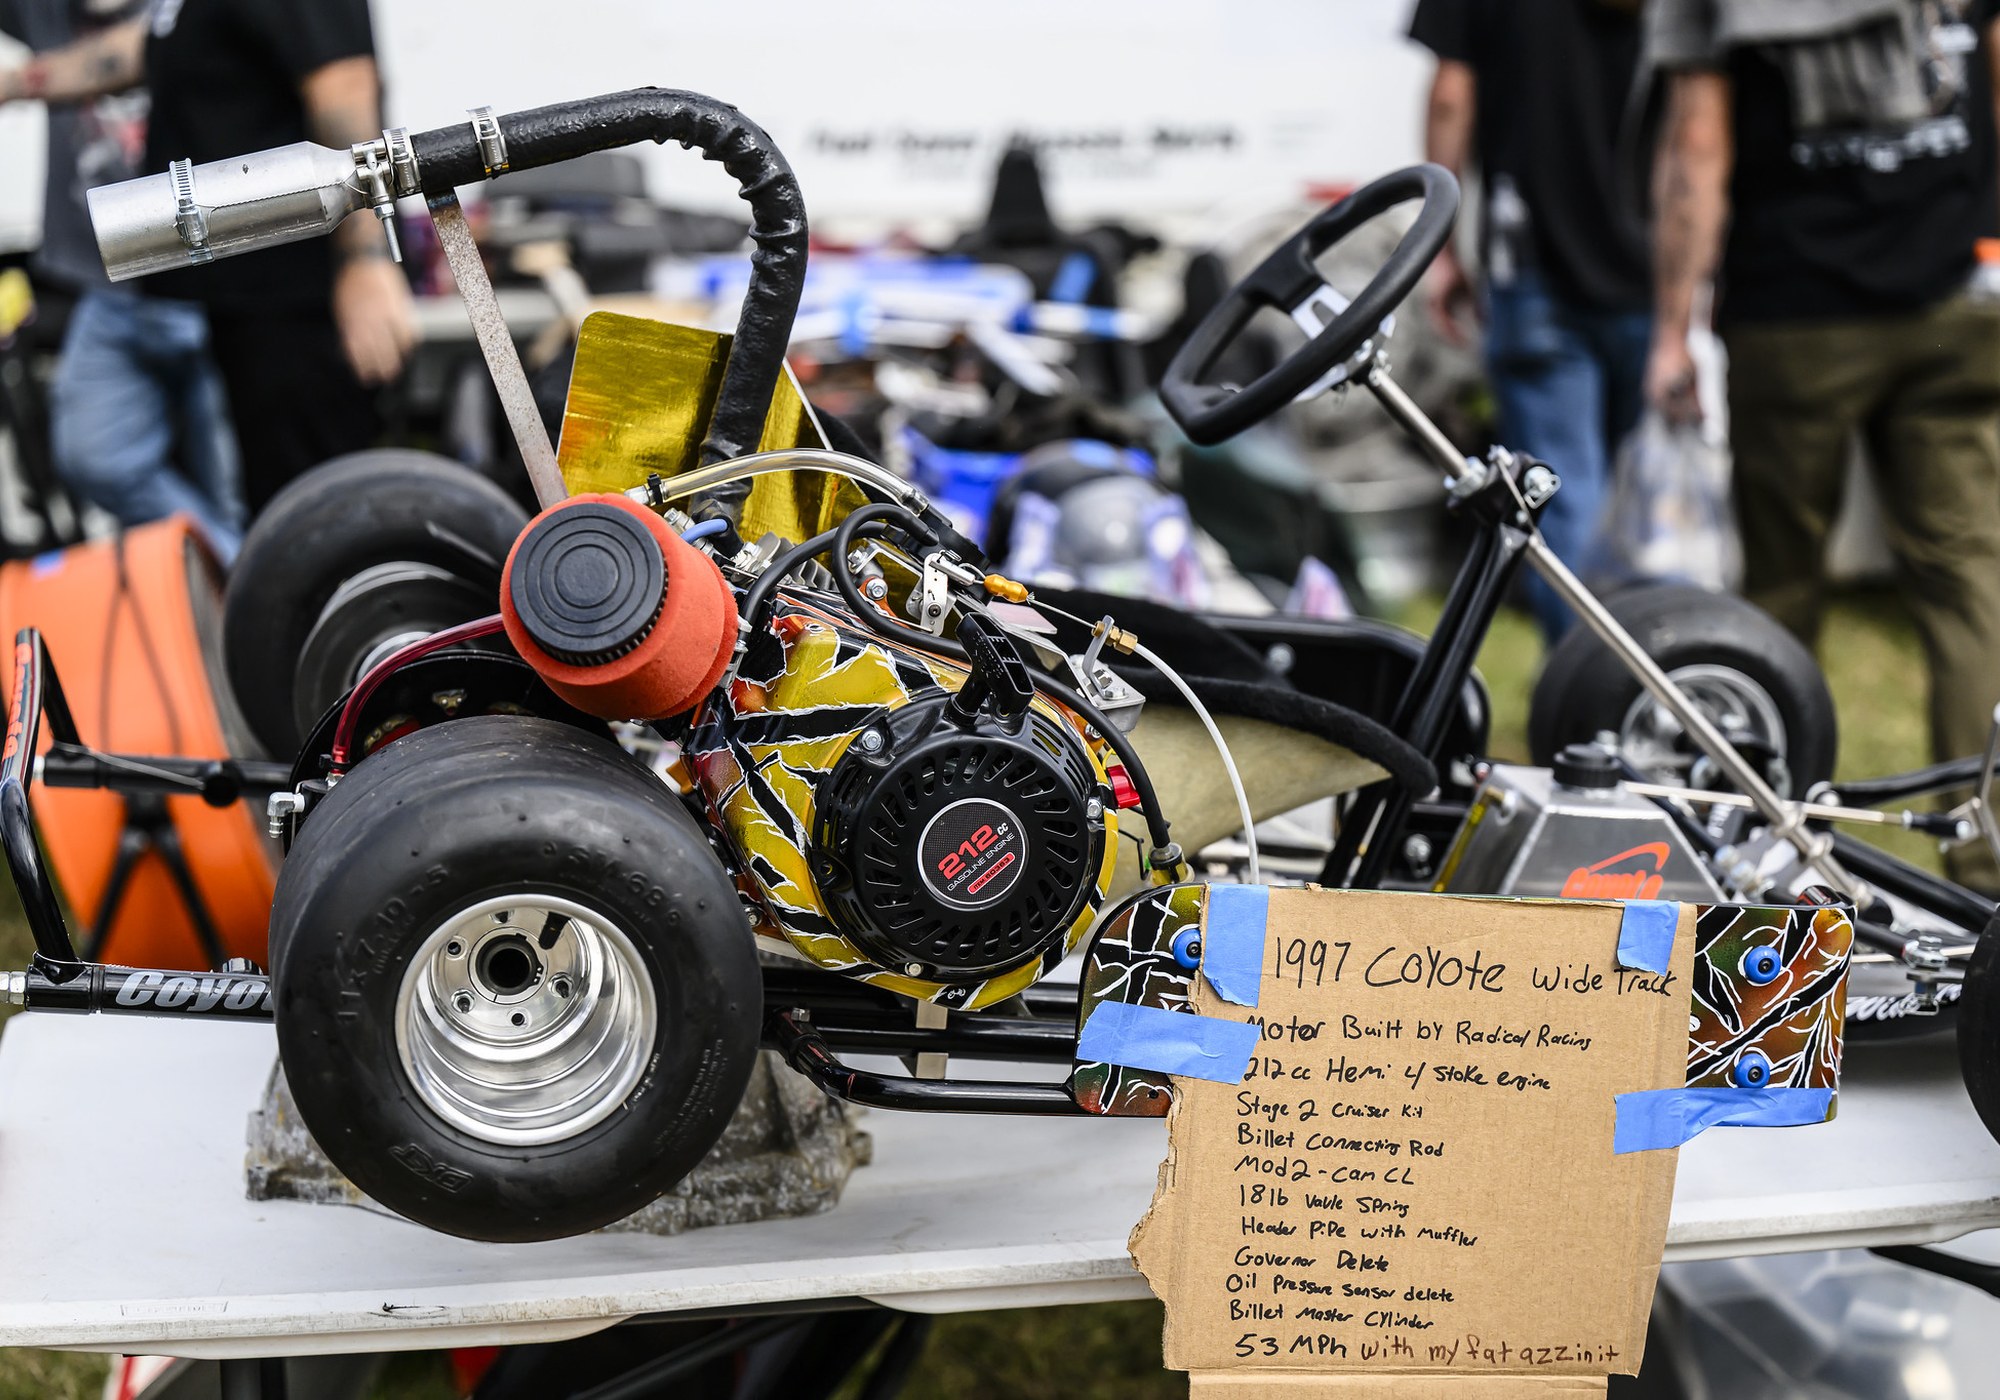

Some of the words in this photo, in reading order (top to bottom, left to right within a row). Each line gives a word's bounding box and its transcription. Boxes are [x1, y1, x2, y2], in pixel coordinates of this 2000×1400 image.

[938, 825, 999, 879] 212
[996, 822, 1009, 836] cc
[947, 857, 986, 891] GASOLINE
[985, 833, 1015, 859] ENGINE
[1276, 936, 1351, 989] 1997
[1532, 963, 1603, 994] Wide
[1613, 966, 1678, 997] Track
[1246, 1014, 1327, 1043] Motor
[1341, 1013, 1403, 1041] Built
[1416, 1019, 1444, 1042] by
[1455, 1020, 1532, 1049] Radical
[1535, 1023, 1593, 1052] Racing
[1325, 1055, 1392, 1084] Hemi
[1496, 1070, 1552, 1091] engine
[1236, 1090, 1290, 1123] Stage
[1297, 1098, 1320, 1122] 2
[1236, 1121, 1295, 1149] Billet
[1304, 1132, 1402, 1157] Connecting
[1408, 1139, 1445, 1158] Rod
[1382, 1166, 1415, 1186] CL
[1355, 1195, 1410, 1218] Spring
[1241, 1215, 1298, 1237] Header
[1309, 1219, 1347, 1240] Pipe
[1360, 1223, 1407, 1240] with
[1416, 1225, 1479, 1247] Muffler
[1233, 1244, 1317, 1267] Governor
[1335, 1249, 1390, 1273] Delete
[1225, 1271, 1257, 1293] Oil
[1402, 1285, 1455, 1303] delete
[1229, 1298, 1284, 1322] Billet
[1294, 1306, 1354, 1323] Master
[1363, 1310, 1435, 1331] Cylinder
[1234, 1332, 1281, 1358] 53
[1360, 1334, 1415, 1361] with
[1427, 1338, 1460, 1366] my
[1465, 1333, 1514, 1365] fat
